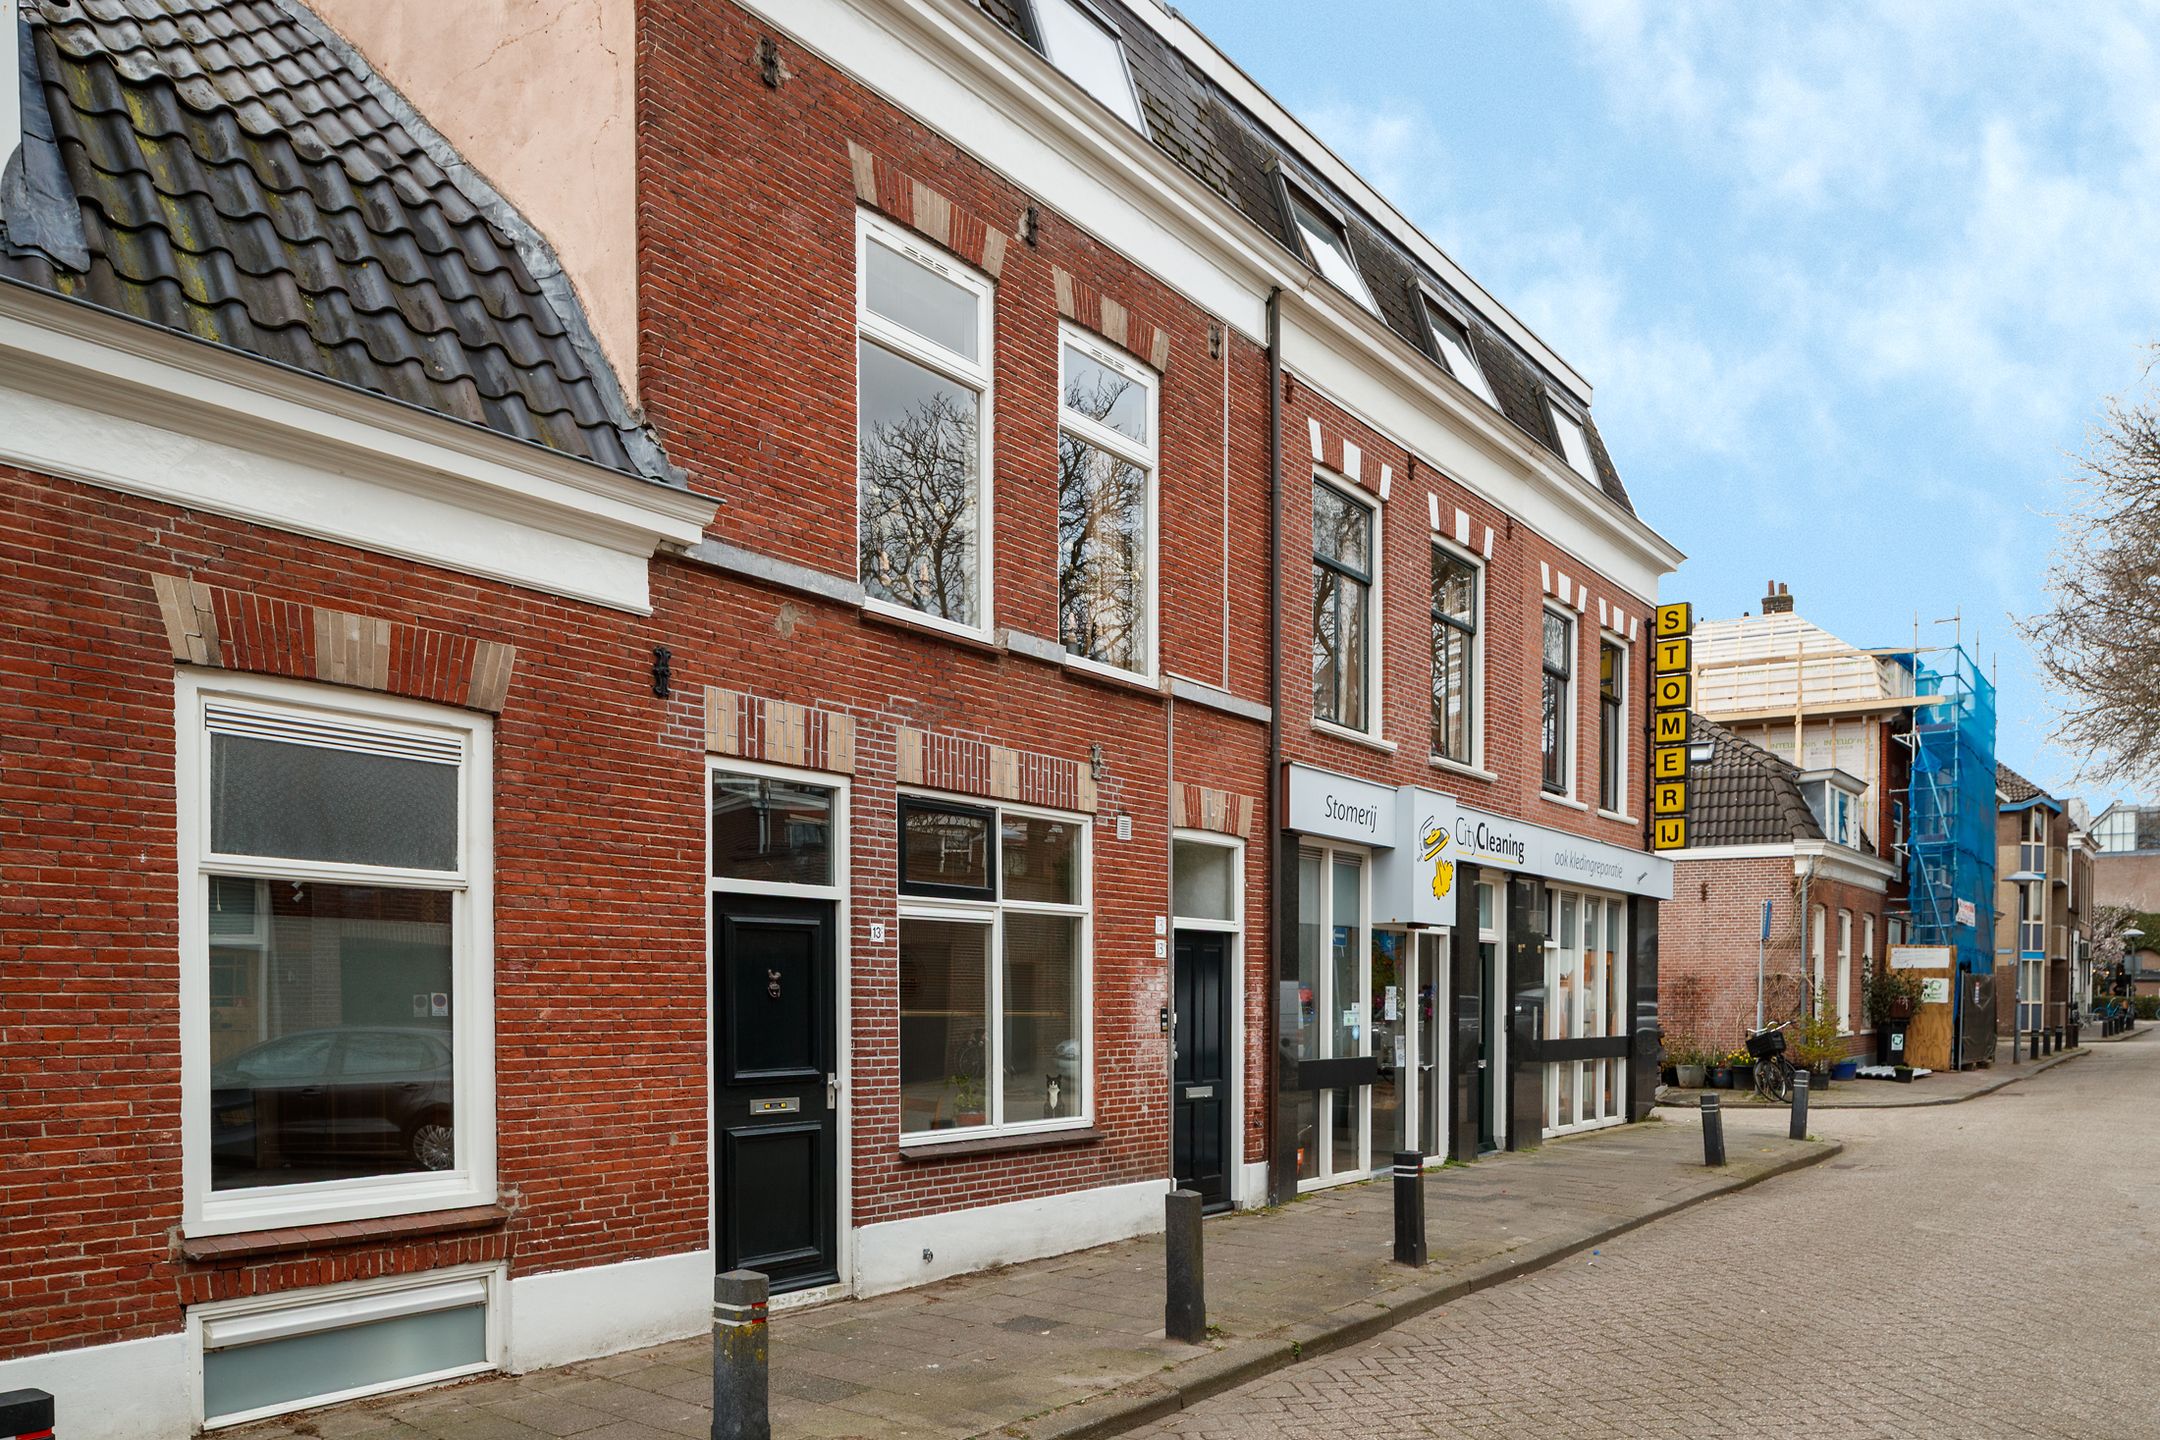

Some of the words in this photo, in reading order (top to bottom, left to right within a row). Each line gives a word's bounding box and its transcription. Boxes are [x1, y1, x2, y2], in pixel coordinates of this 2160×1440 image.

[1661, 610, 1680, 843] STOMERIJ
[1324, 794, 1377, 833] Stomerij
[1554, 850, 1569, 867] ook
[1569, 851, 1623, 879] kledingreparatie
